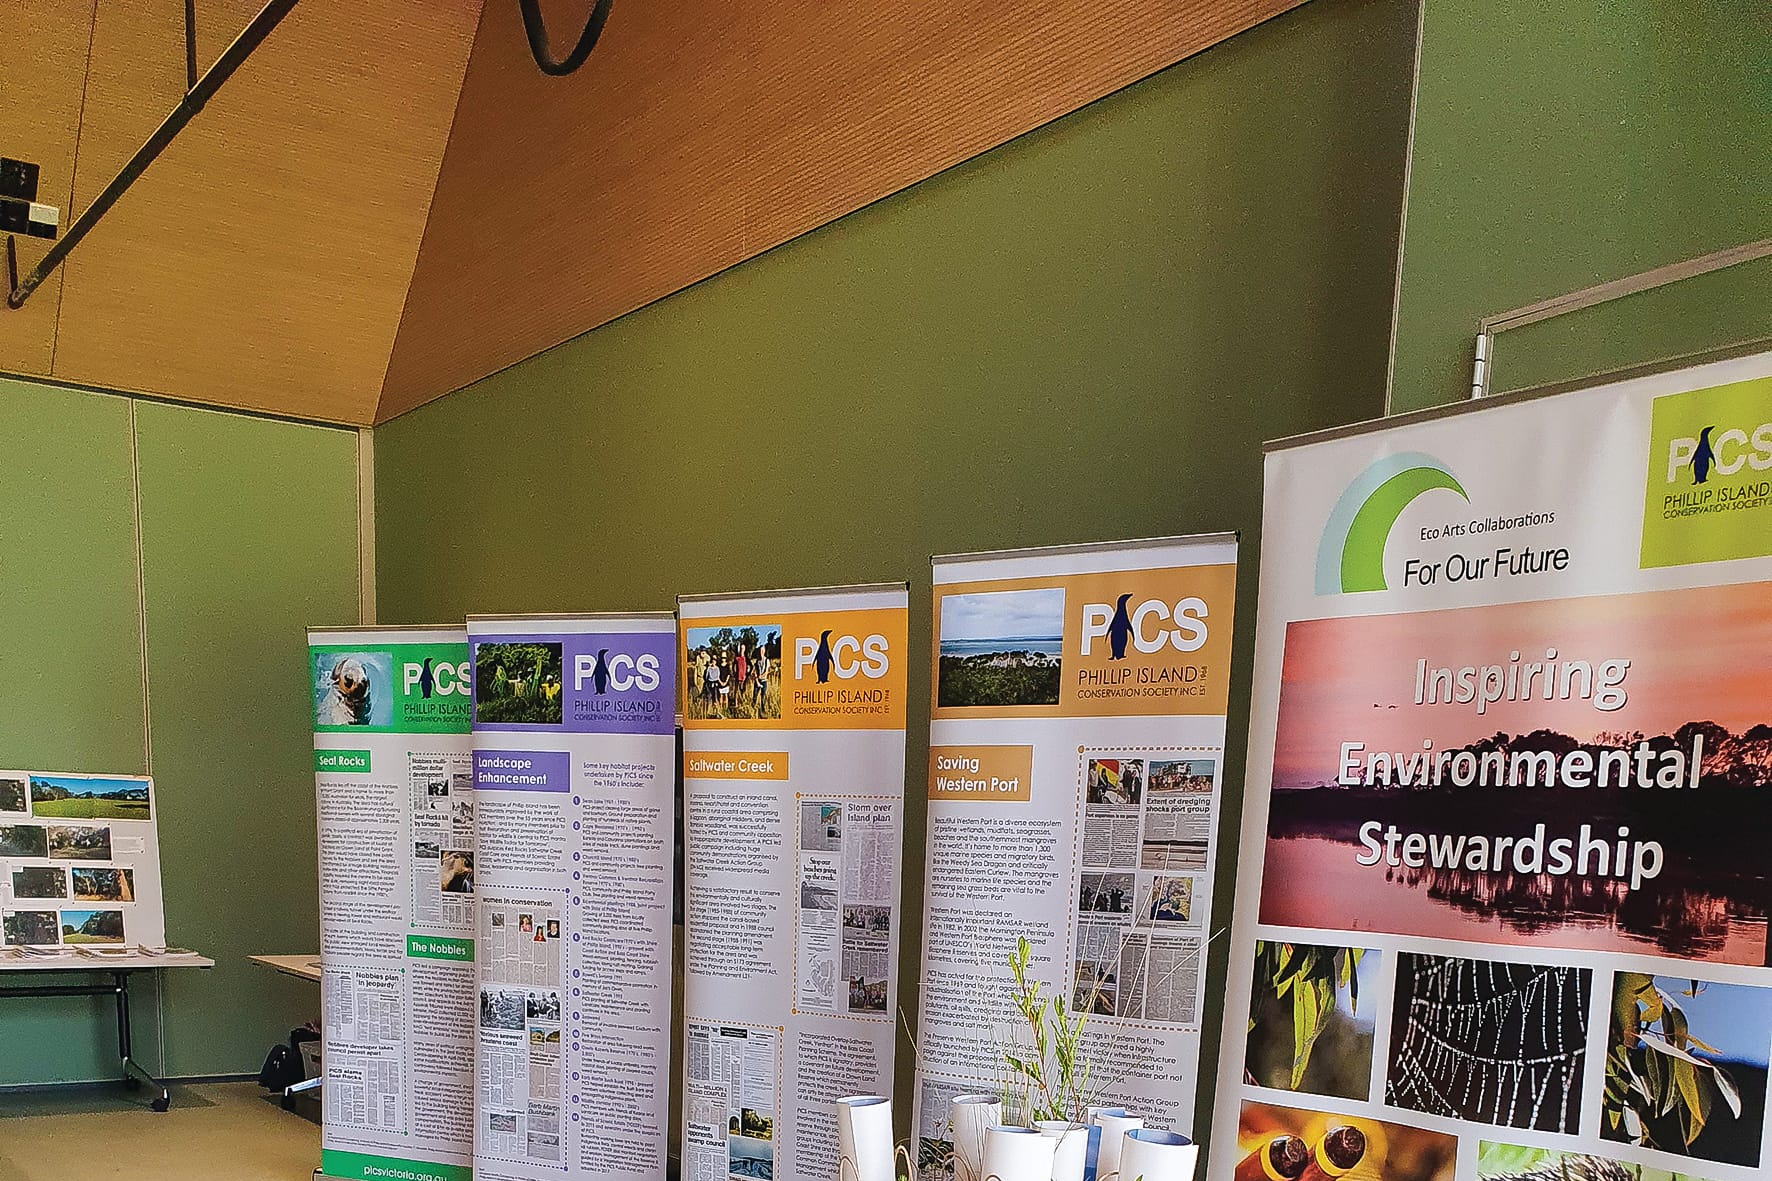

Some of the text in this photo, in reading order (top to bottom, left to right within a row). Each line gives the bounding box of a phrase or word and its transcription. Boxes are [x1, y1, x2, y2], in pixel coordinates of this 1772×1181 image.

[1664, 482, 1769, 509] PHILLIP ISLAND
[1664, 498, 1767, 519] CONSERVATION SOCIETY
[1420, 511, 1555, 540] Eco Arts Collaborations
[1404, 546, 1569, 586] For Our Future
[1081, 593, 1208, 661] PICS
[794, 630, 889, 684] PICS
[574, 649, 660, 695] PICS
[1079, 666, 1198, 685] PHILLIP ISLAND
[1414, 648, 1633, 715] Inspiring
[794, 690, 883, 704] PHILLIP ISLAND
[1078, 687, 1198, 698] CONSERVATION SOCIETY INC
[404, 704, 437, 715] PHILLIP
[574, 701, 655, 713] PHILLIP ISLAND
[794, 706, 841, 715] CONSERVATION
[842, 706, 868, 715] SOCIETY
[319, 756, 365, 766] Seal Rocks
[478, 757, 532, 770] Landscape
[689, 759, 773, 773] Saltwater Creek
[937, 755, 980, 773] Saving
[1338, 734, 1704, 789] Environmental
[478, 772, 547, 785] Enhancement
[936, 777, 1019, 792] Western Port
[873, 814, 890, 823] plan
[1355, 820, 1665, 891] Stewardship
[412, 942, 466, 955] The Nobbies
[356, 972, 399, 982] Nobbies plan
[1158, 1098, 1179, 1107] Group
